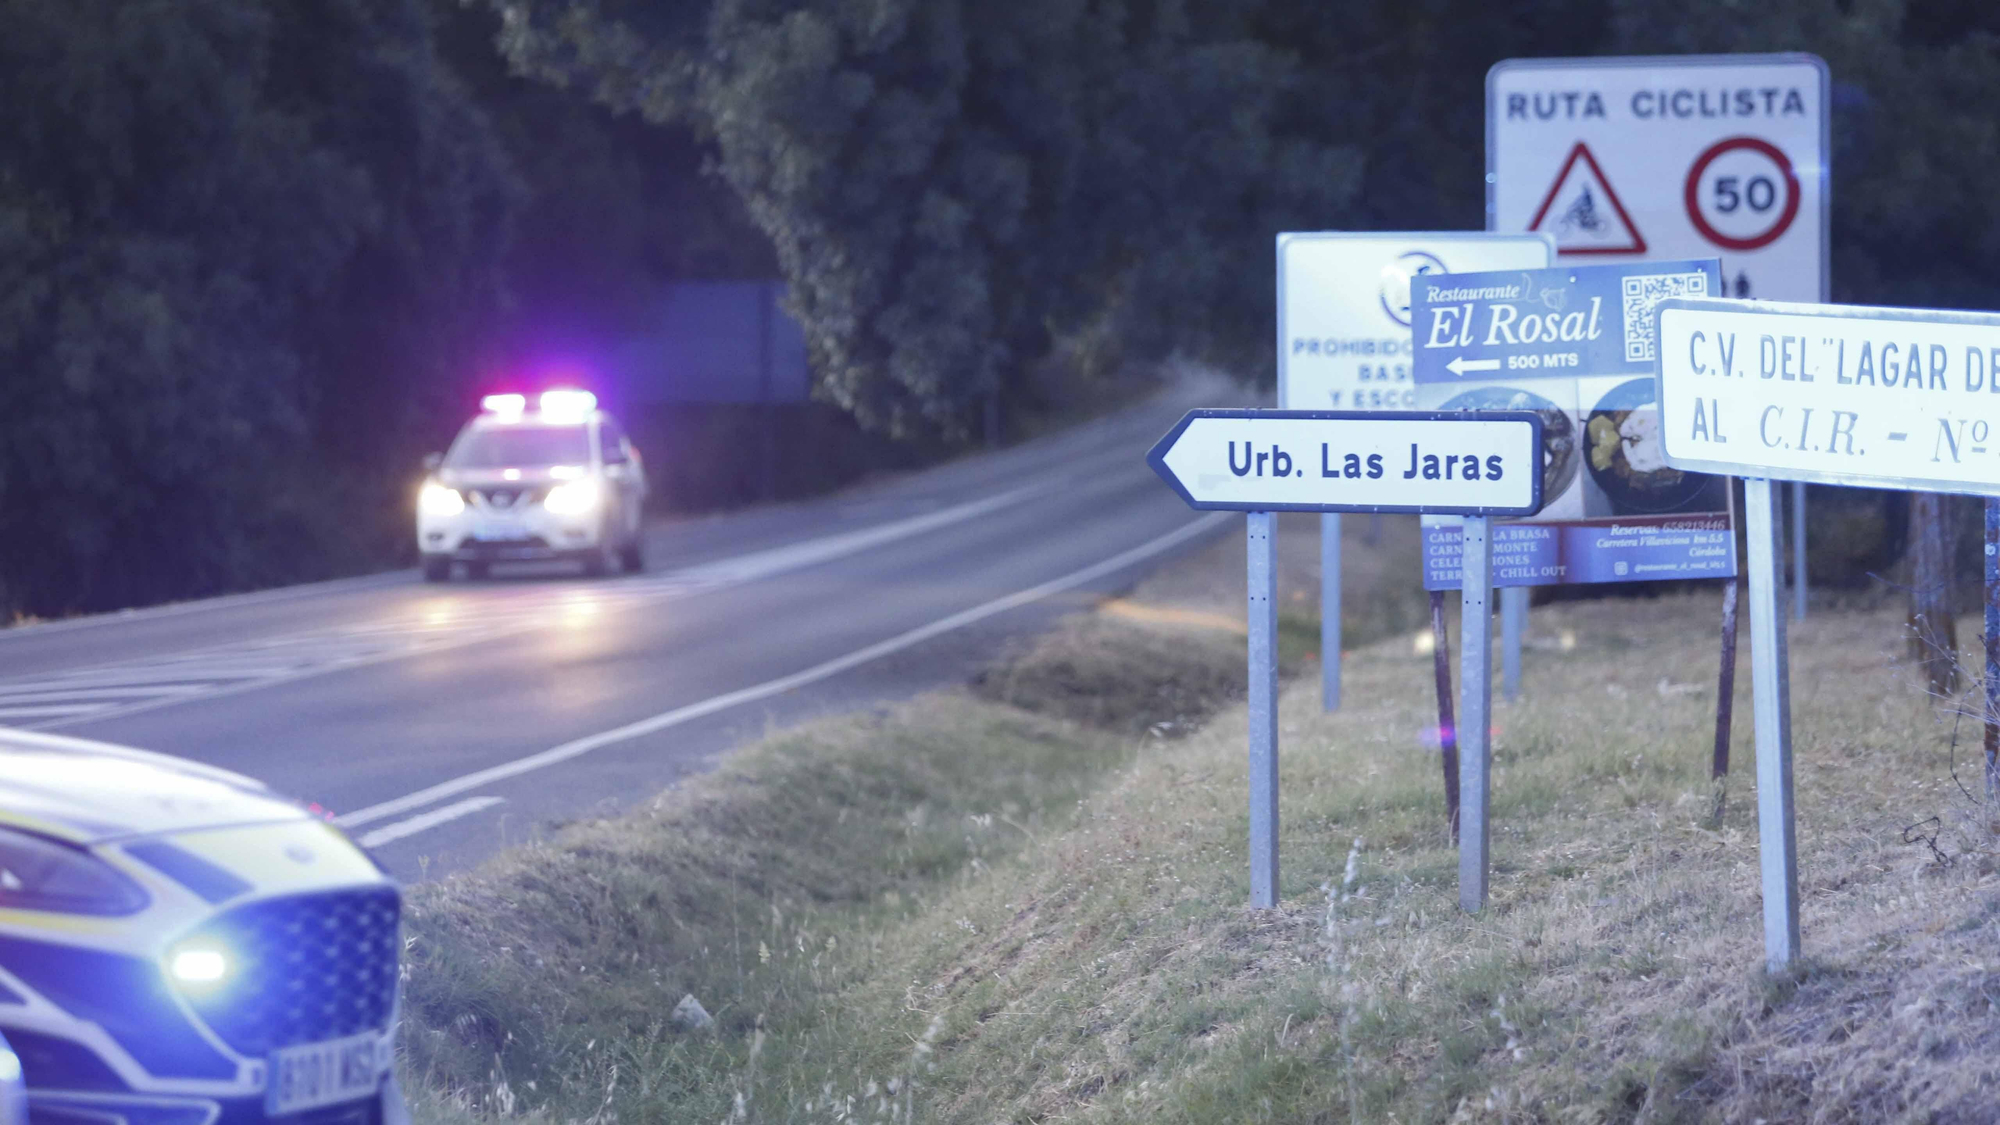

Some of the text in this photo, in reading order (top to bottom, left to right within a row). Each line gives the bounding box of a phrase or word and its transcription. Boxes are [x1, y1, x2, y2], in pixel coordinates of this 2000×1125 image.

[1506, 87, 1806, 120] RUTA CICLISTA
[1714, 175, 1776, 213] 50
[1427, 284, 1520, 303] Restaurante
[1424, 296, 1603, 349] El Rosal
[1507, 352, 1579, 370] 500 MTS
[1689, 330, 1744, 378] C.V.
[1760, 334, 1814, 382] DEL
[1965, 346, 2000, 394] DE
[1358, 364, 1412, 381] BAS
[1329, 388, 1419, 408] Y ESCO
[1691, 397, 1727, 444] AL
[1759, 404, 1865, 456] C.I.R.
[1228, 441, 1504, 481] Urb. Las Jaras
[1429, 532, 1463, 543] CARN
[1510, 529, 1550, 540] BRASA
[1430, 545, 1463, 556] CARN
[1430, 565, 1567, 581] TERR CHILL OUT
